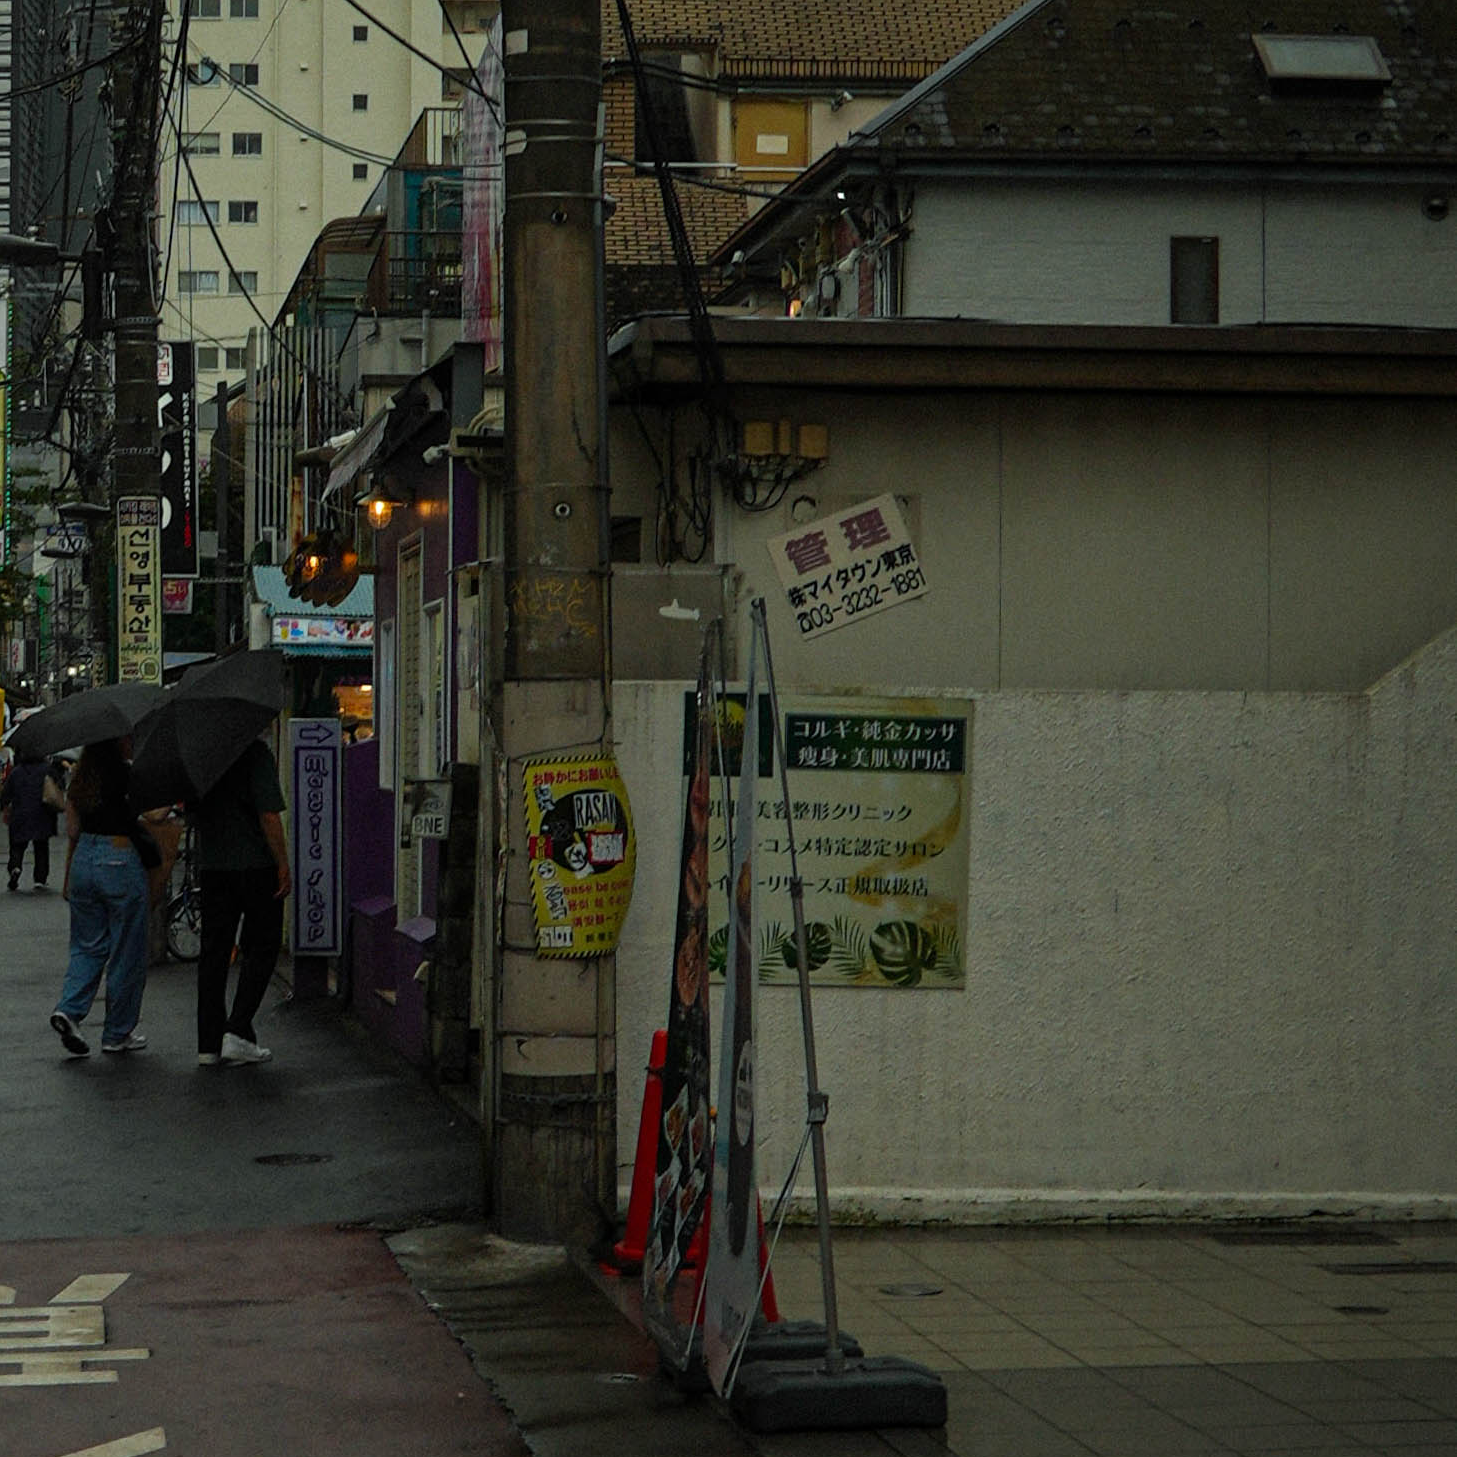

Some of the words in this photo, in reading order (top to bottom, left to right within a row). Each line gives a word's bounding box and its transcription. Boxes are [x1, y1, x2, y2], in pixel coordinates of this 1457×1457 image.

[785, 506, 892, 576] 管理
[128, 528, 152, 634] 선영부동산
[792, 719, 959, 743] コルギ・純金カッサ
[414, 816, 443, 834] BNE
